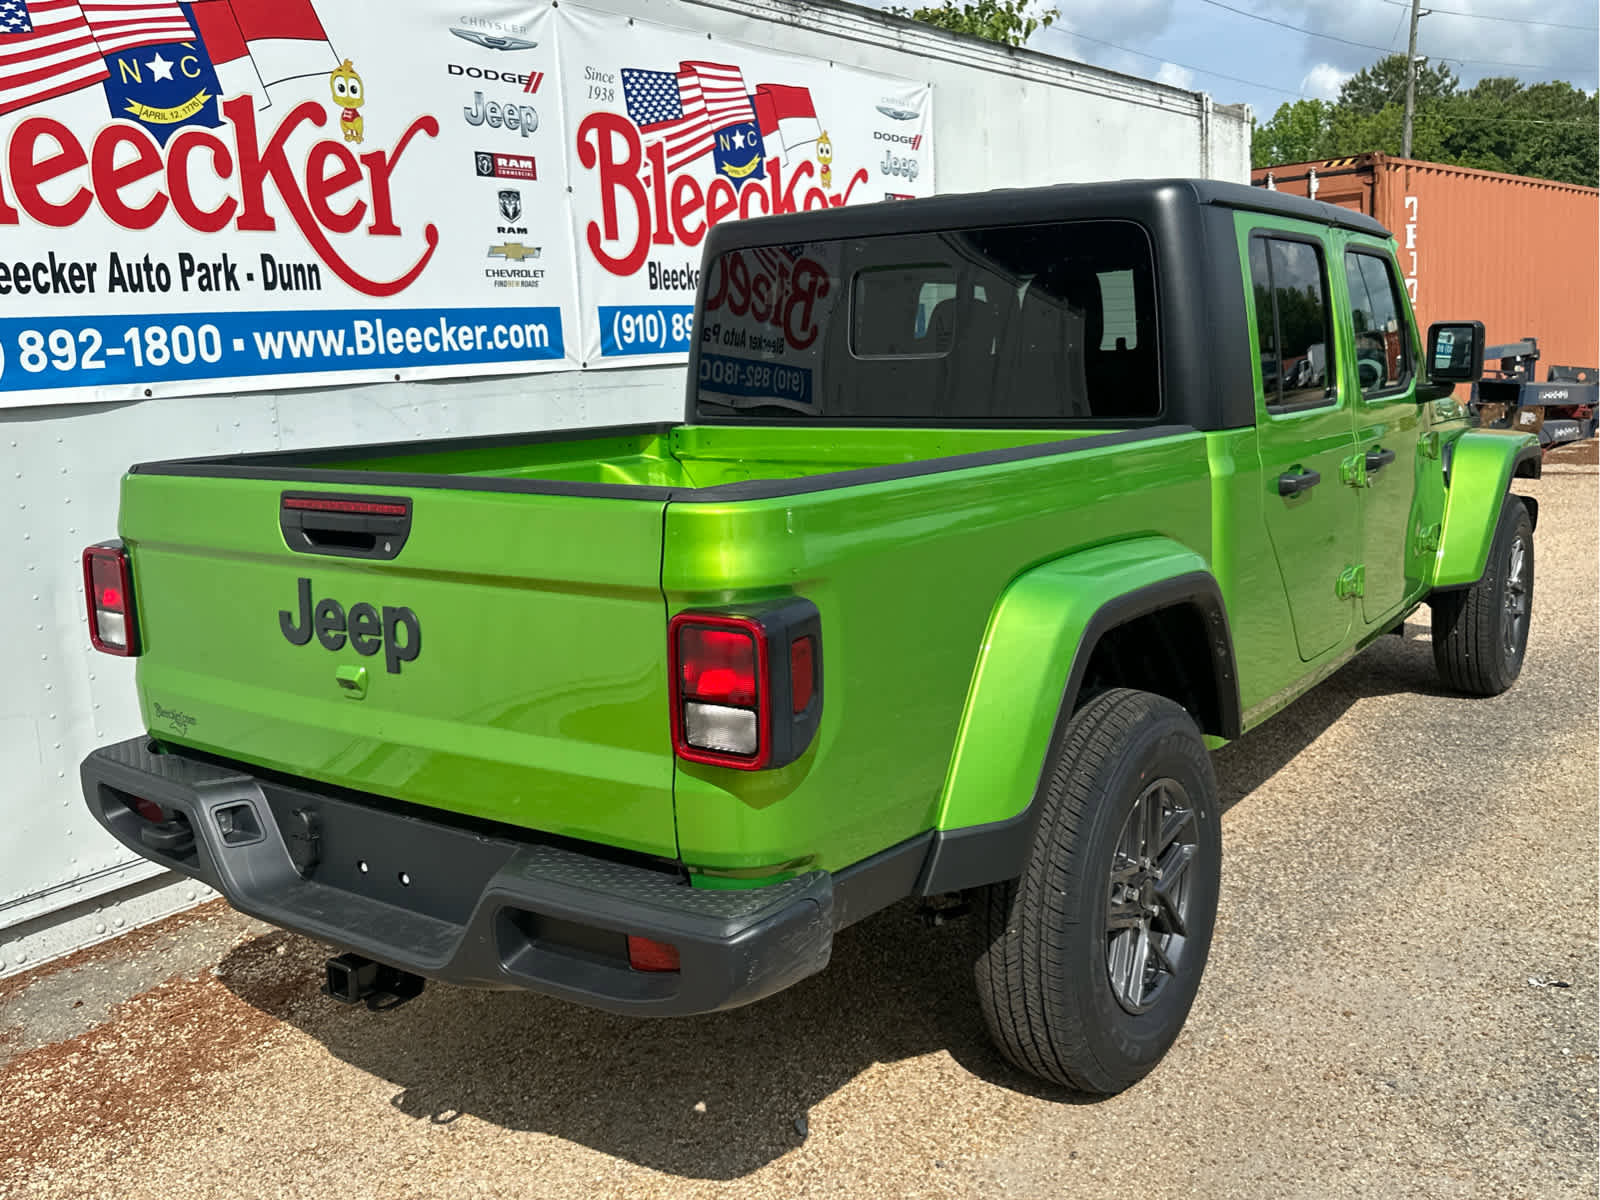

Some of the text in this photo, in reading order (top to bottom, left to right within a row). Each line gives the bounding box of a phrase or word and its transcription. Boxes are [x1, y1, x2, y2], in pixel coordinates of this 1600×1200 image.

[460, 15, 528, 34] CHRYSLER
[118, 55, 201, 84] N C
[447, 63, 532, 86] DODGE
[584, 65, 615, 84] Since
[588, 85, 615, 103] 1938
[142, 108, 168, 120] APRIL
[183, 100, 201, 114] 1776
[463, 91, 539, 137] Jeep
[719, 130, 758, 152] N C
[873, 131, 916, 145] DODGE
[496, 157, 533, 169] RAM
[880, 149, 919, 183] Jeep
[497, 226, 528, 235] RAM
[108, 252, 171, 293] Auto
[178, 252, 241, 293] Park
[260, 252, 322, 291] Dunn
[485, 268, 545, 279] CHEVROLET
[613, 309, 667, 351] (910)
[18, 323, 223, 374] 892-1800
[252, 316, 550, 360] www.Bleecker.com
[278, 577, 421, 675] Jeep
